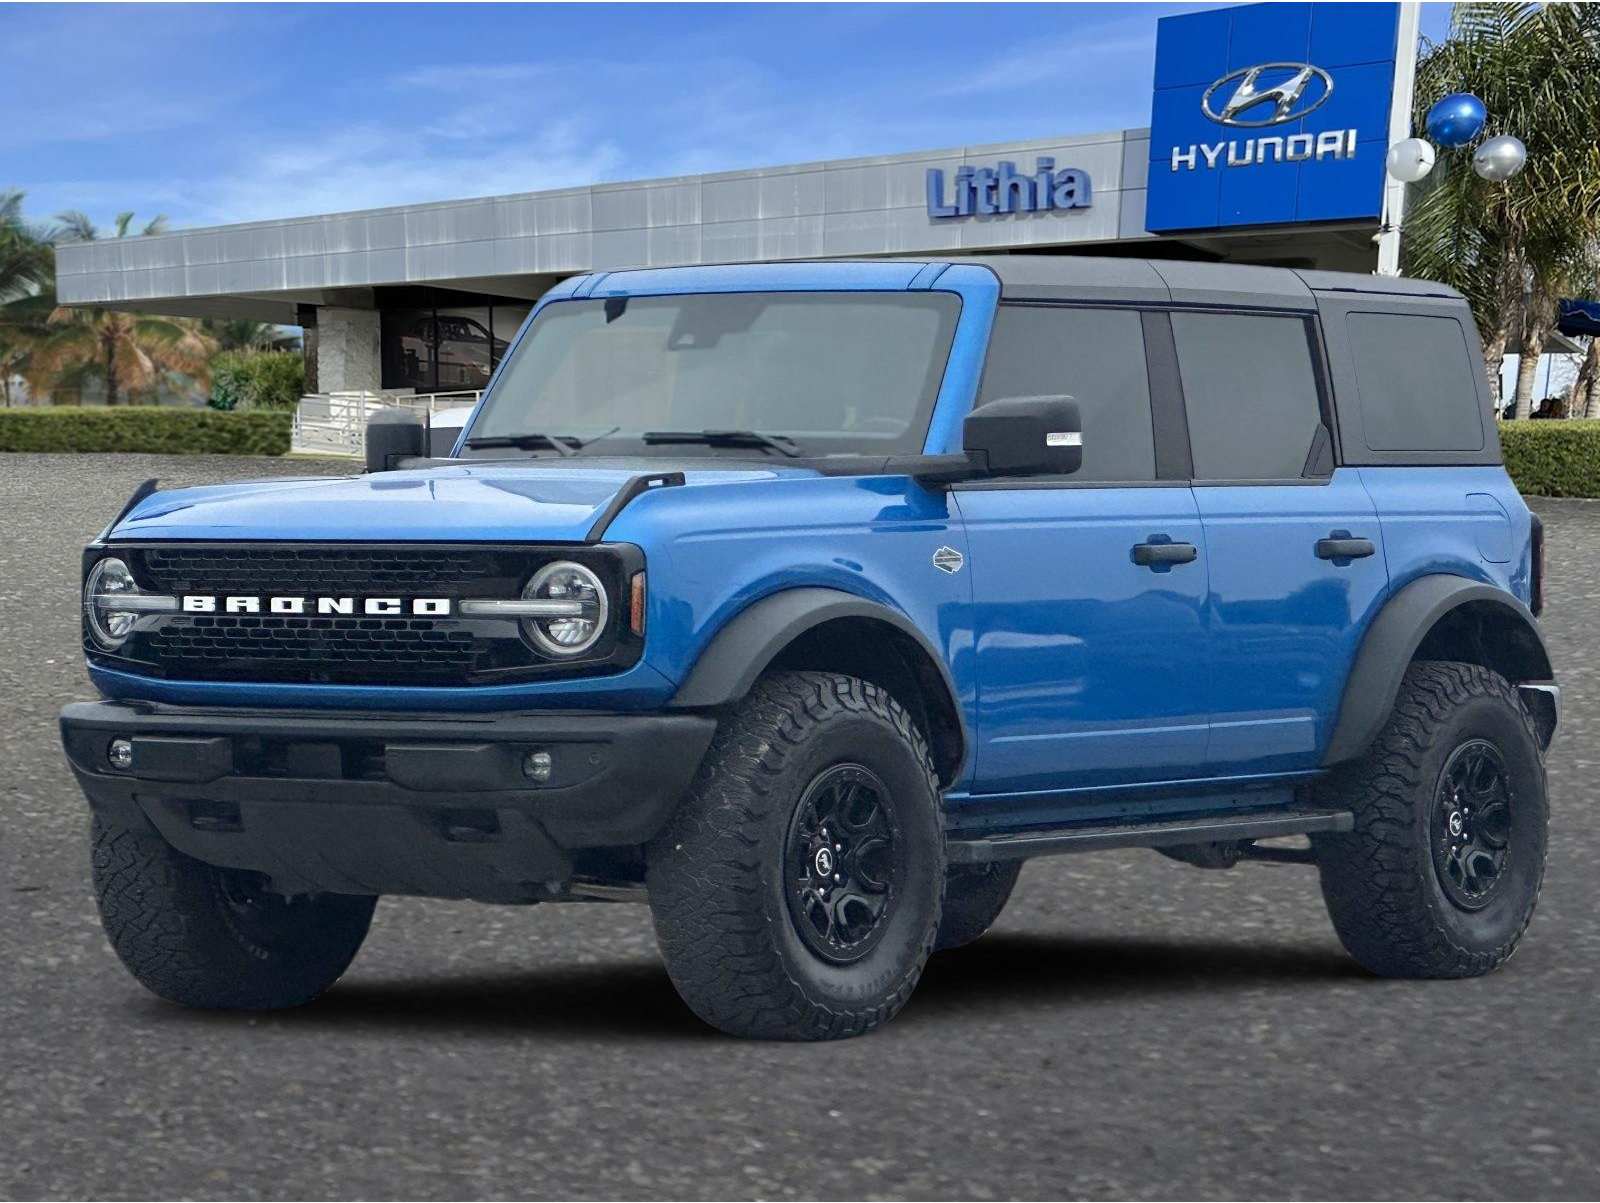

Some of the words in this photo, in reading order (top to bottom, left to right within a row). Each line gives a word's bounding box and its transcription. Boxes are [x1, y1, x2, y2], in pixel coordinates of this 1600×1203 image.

[1171, 129, 1357, 171] HYUNDAI
[926, 157, 1092, 219] Lithia
[182, 595, 451, 615] BRONCO
